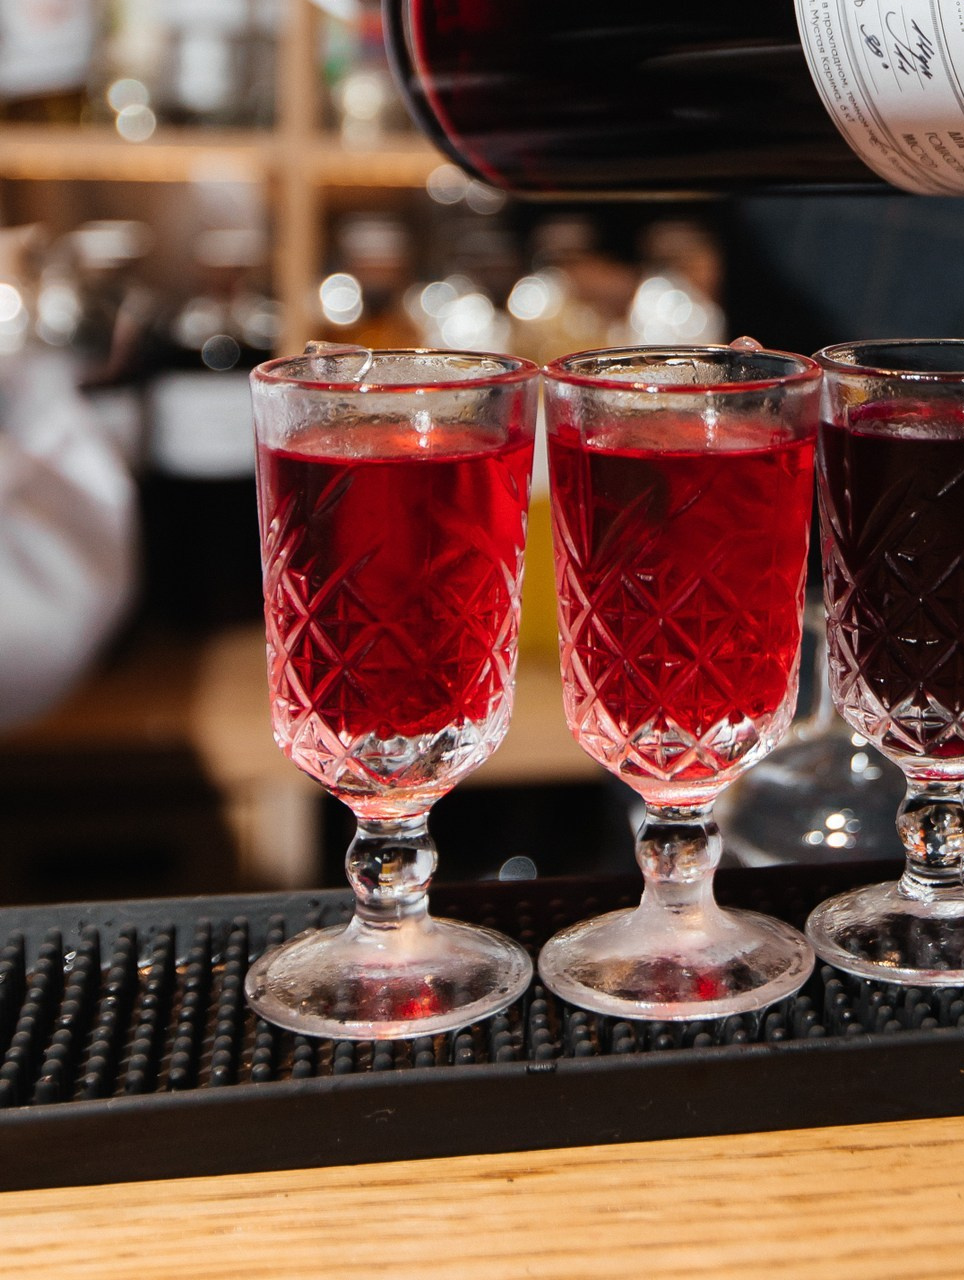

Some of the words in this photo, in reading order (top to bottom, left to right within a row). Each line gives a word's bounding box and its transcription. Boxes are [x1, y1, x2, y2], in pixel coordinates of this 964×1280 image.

[822, 1, 828, 9] в
[811, 9, 825, 55] Мустая
[822, 56, 842, 104] Карима,
[823, 12, 849, 89] прохладном,
[846, 91, 869, 128] темном
